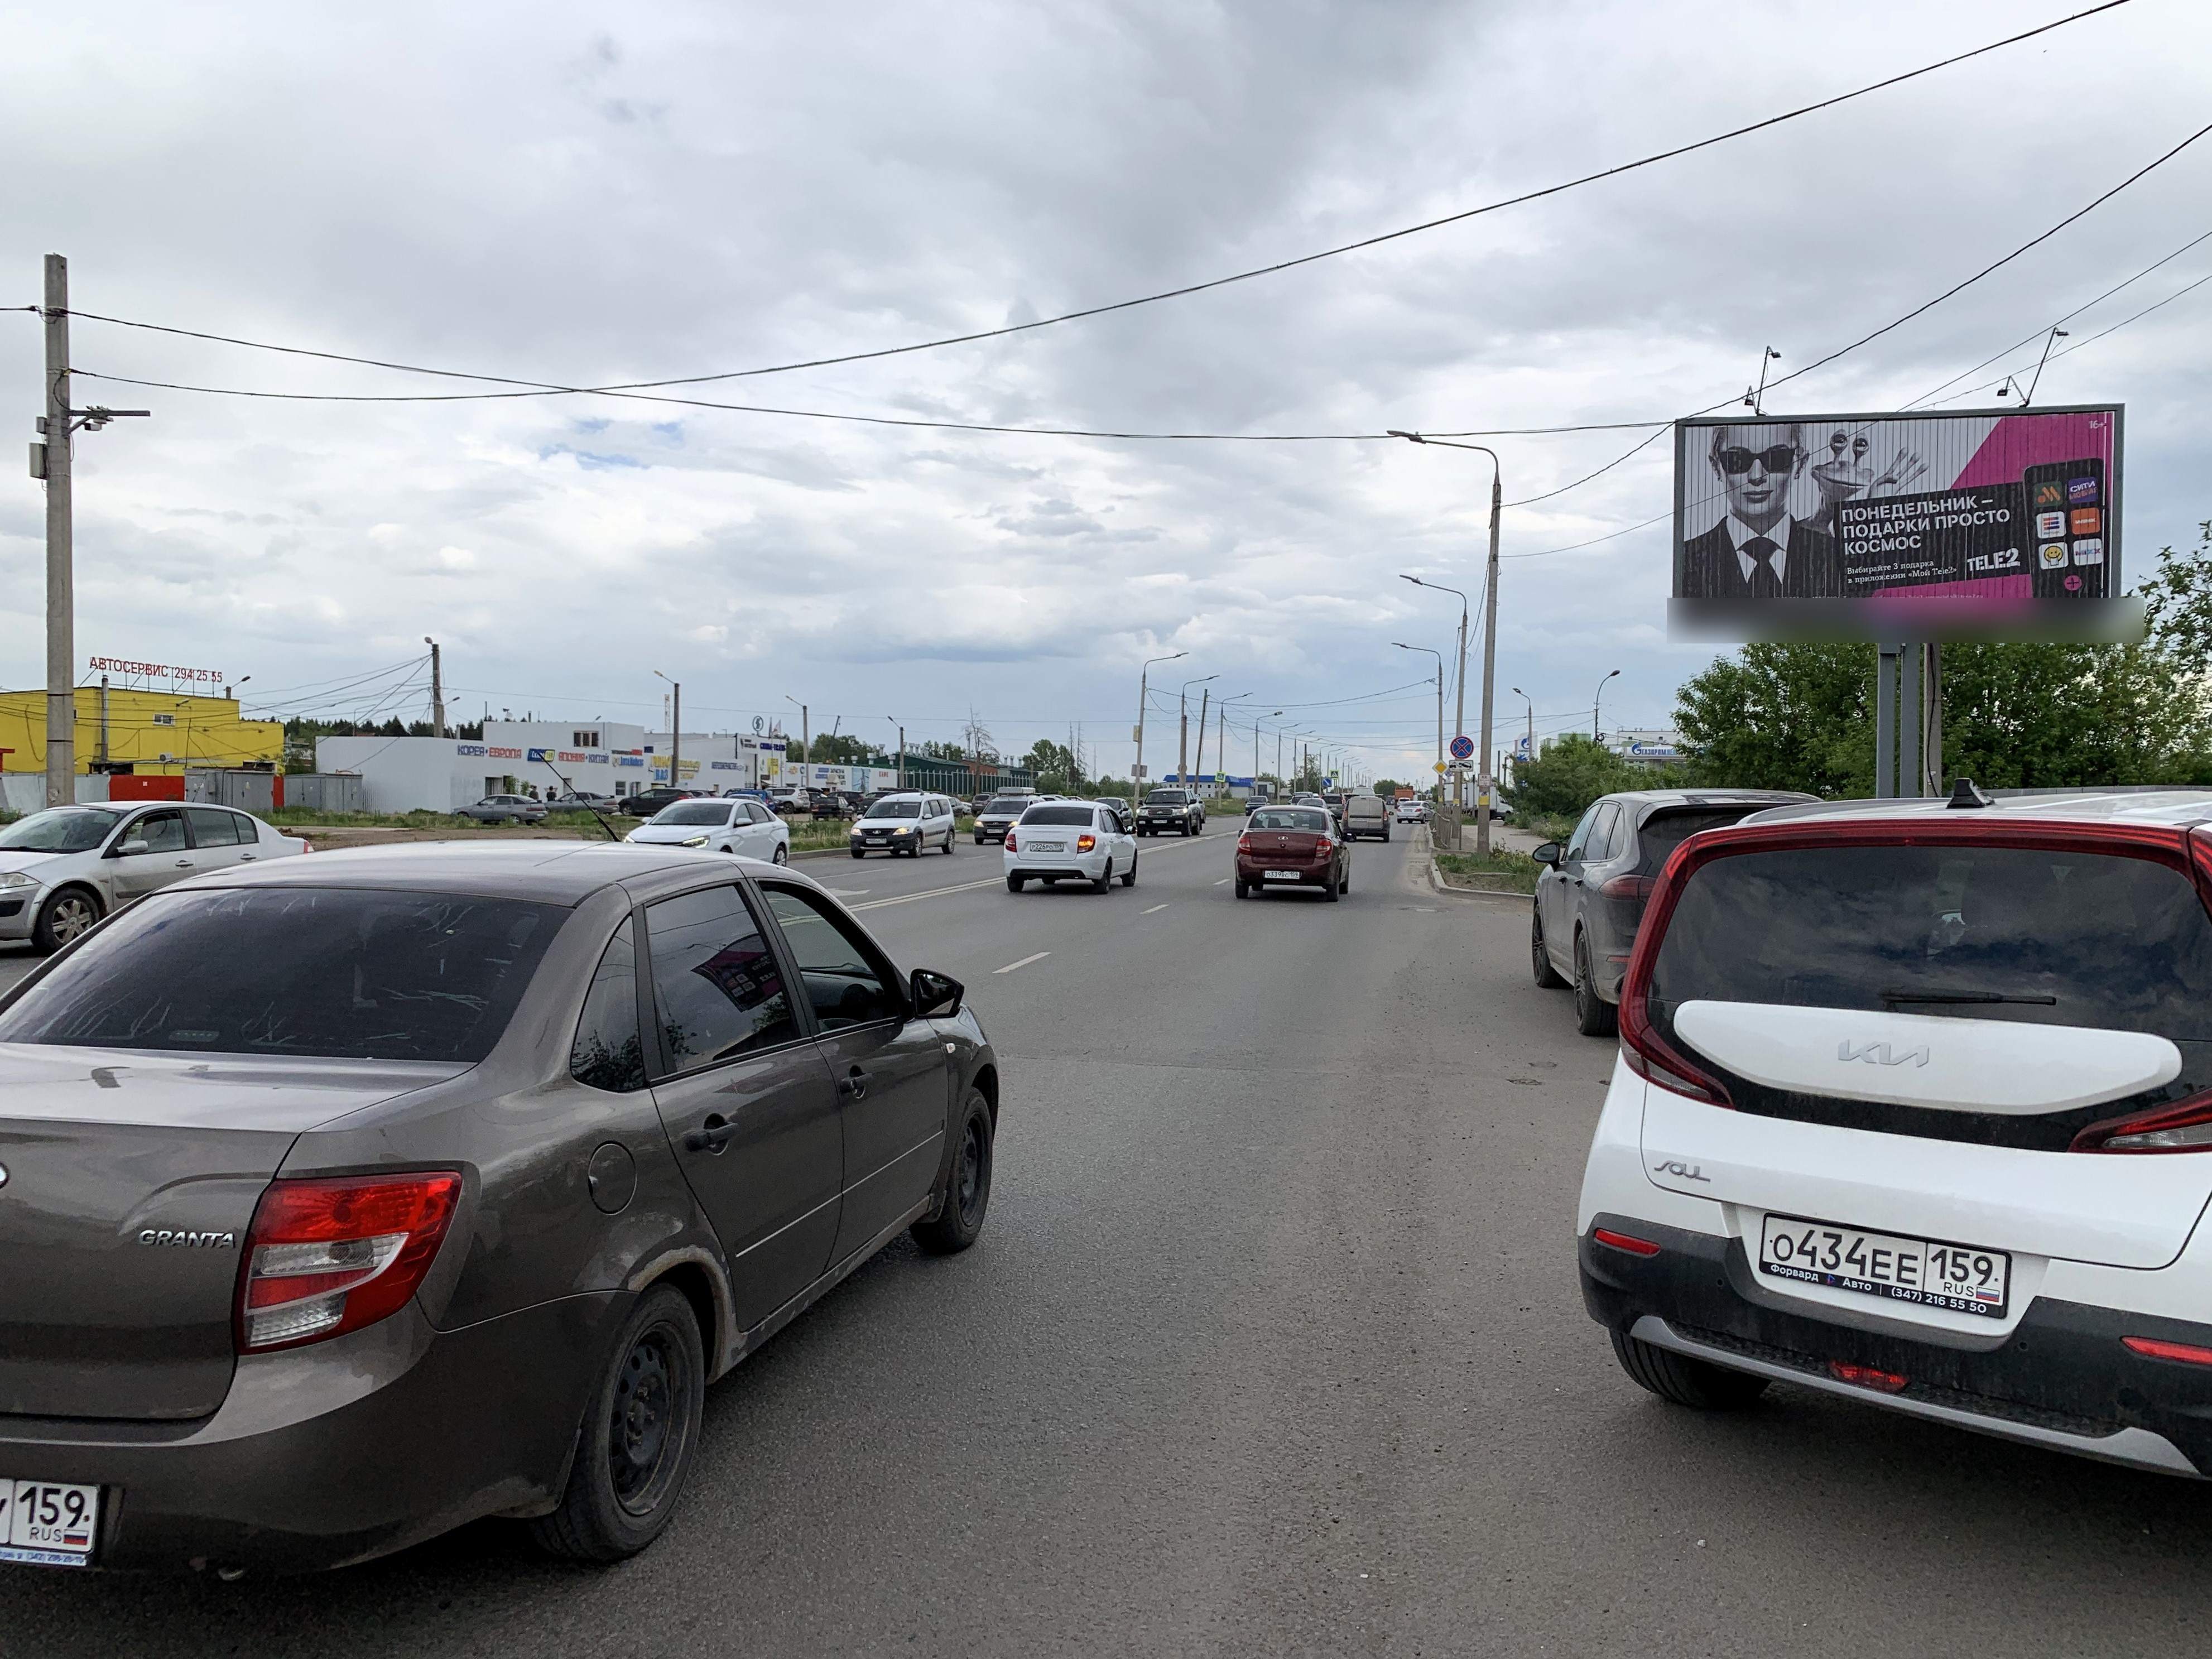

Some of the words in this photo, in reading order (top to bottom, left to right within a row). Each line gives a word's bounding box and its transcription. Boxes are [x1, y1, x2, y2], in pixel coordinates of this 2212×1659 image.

[1842, 495, 1978, 523] ПОНЕДЕЛЬНИК
[1843, 518, 1930, 538] ПОДАРКИ
[1935, 508, 2010, 530] ПРОСТО
[1844, 535, 1921, 555] КОСМОС
[1847, 564, 1891, 575] Выбирайте
[1900, 560, 1934, 571] подарка
[1967, 547, 2021, 571] TELE2
[1855, 573, 1906, 584] приложении
[1908, 569, 1931, 578] «Мой
[89, 657, 168, 677] АВТОСЕРВИС
[175, 667, 193, 680] 294
[197, 670, 208, 681] 25
[211, 671, 223, 682] 55
[458, 744, 484, 756] КОРЕЯ
[489, 747, 522, 759] ЕВРОПА
[1838, 1039, 1930, 1067] KIA
[1653, 1160, 1711, 1182] SOUL
[139, 1229, 236, 1248] GRANTA
[1931, 1249, 1993, 1286] 159
[1771, 1263, 1819, 1283] Форвард
[1843, 1279, 1872, 1291] Авто
[1891, 1286, 1922, 1302] (347)
[1926, 1293, 1946, 1306] 216
[1950, 1298, 1966, 1310] 55
[1969, 1302, 1987, 1314] 50
[1944, 1282, 1974, 1297] RUS
[19, 1485, 85, 1527] 159
[29, 1527, 62, 1542] RUS
